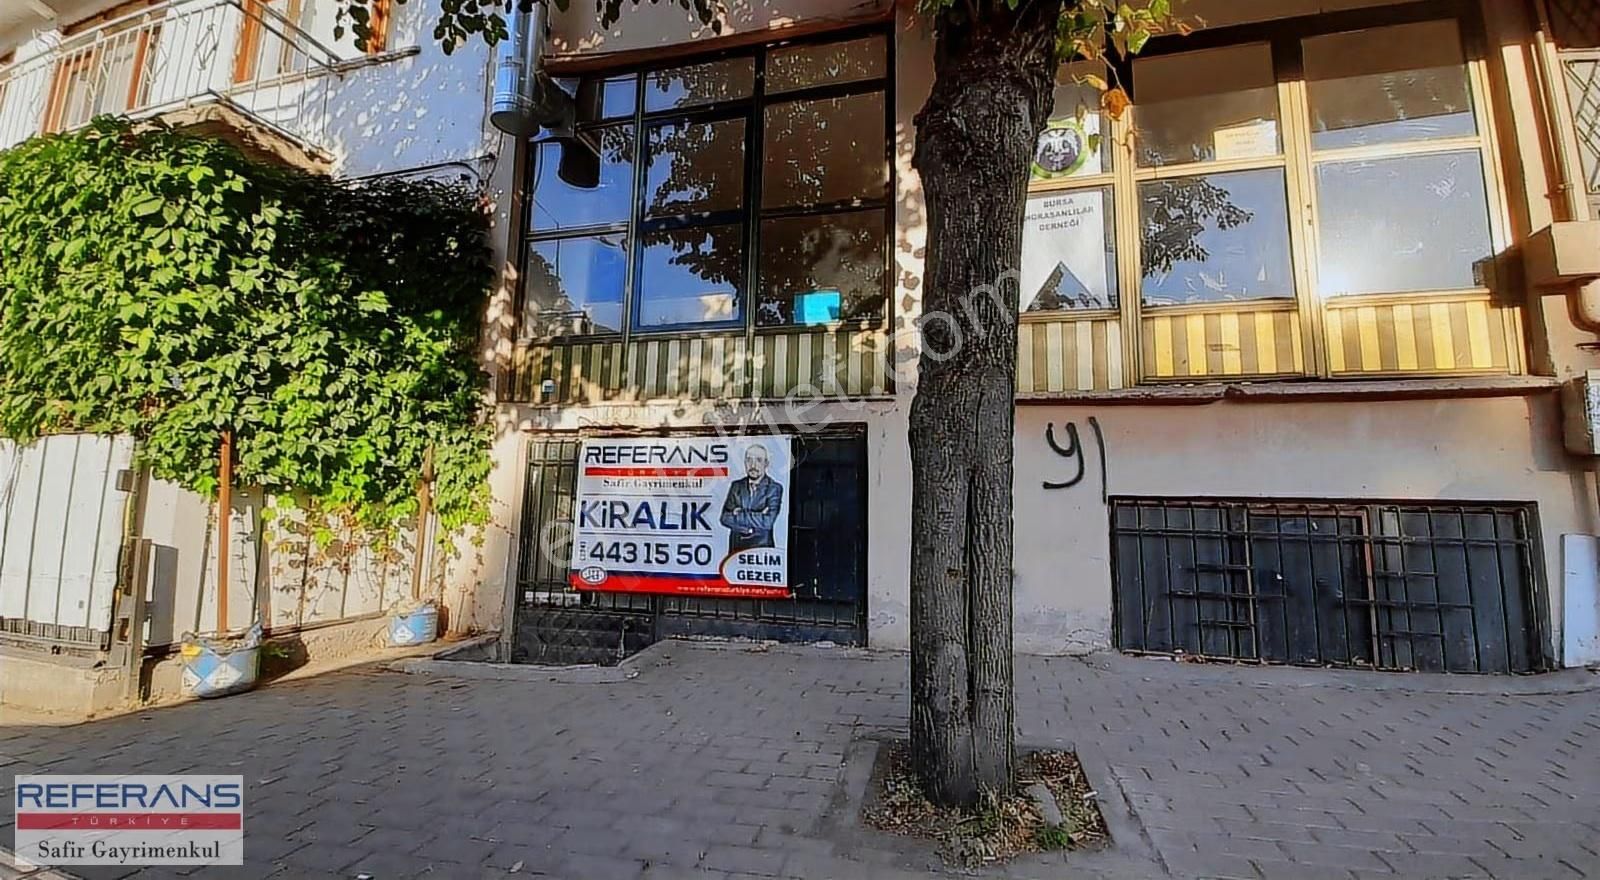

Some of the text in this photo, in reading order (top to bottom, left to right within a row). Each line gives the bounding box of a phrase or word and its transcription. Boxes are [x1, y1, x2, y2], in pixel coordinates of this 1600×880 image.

[585, 445, 729, 464] REFERANS
[590, 541, 638, 564] 443
[643, 542, 670, 565] 15
[676, 544, 712, 567] 50
[738, 551, 781, 566] SELİM
[737, 569, 781, 583] GEZER
